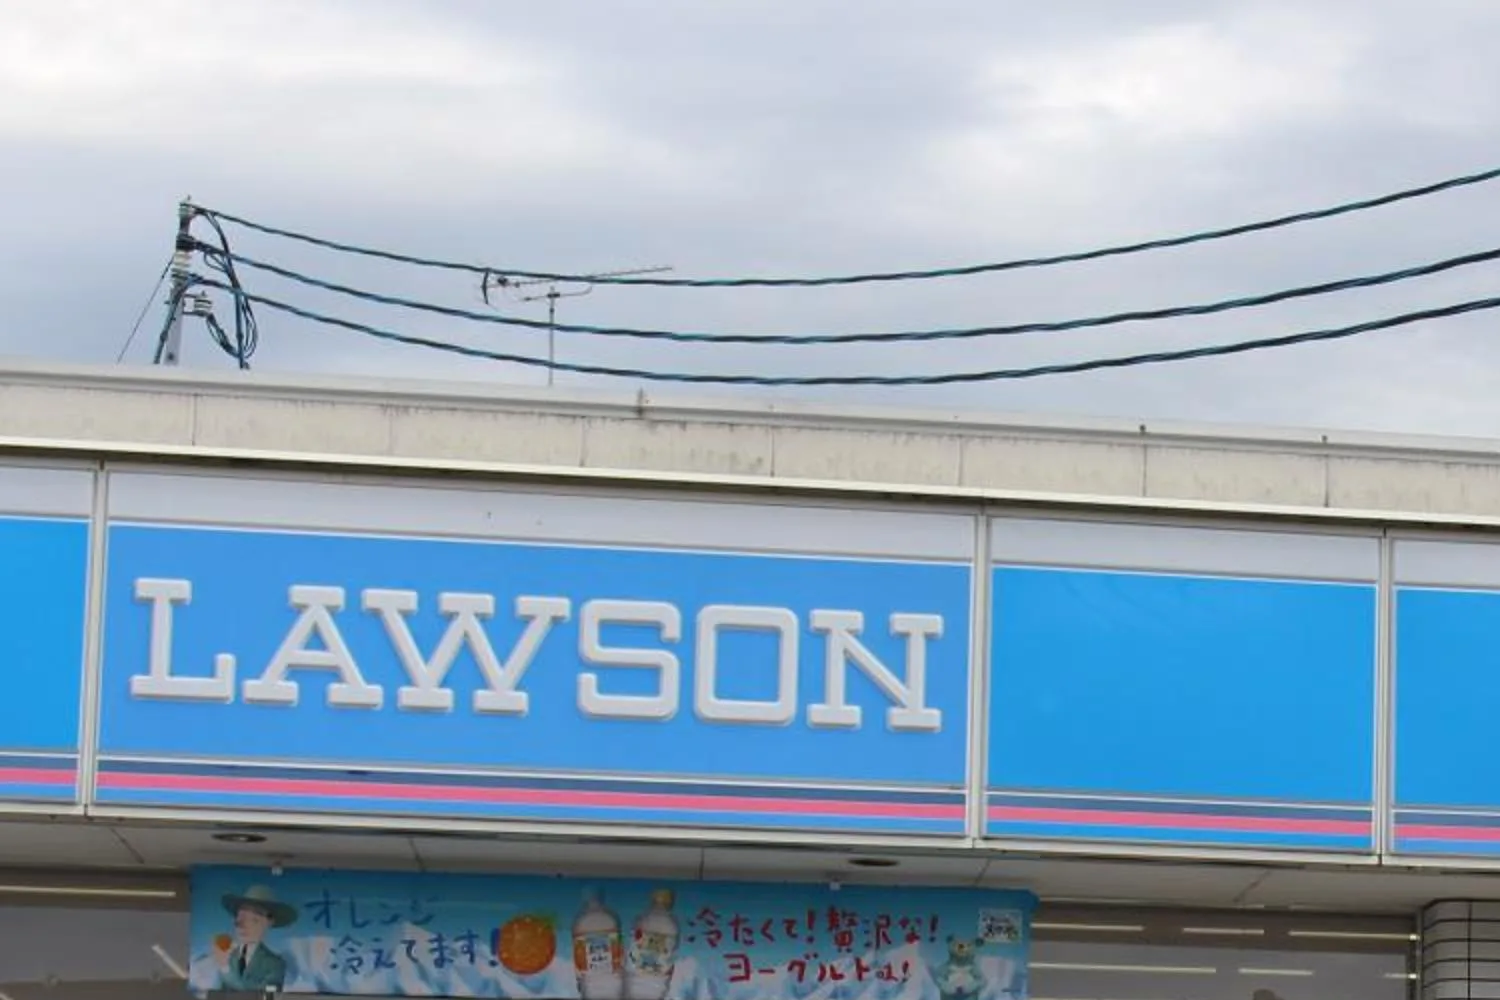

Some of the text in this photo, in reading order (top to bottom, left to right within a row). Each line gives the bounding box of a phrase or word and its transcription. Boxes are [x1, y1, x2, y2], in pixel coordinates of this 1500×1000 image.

[130, 576, 944, 734] LAWSON
[305, 889, 437, 929] オレンジ
[329, 927, 500, 975] 冷えてます!
